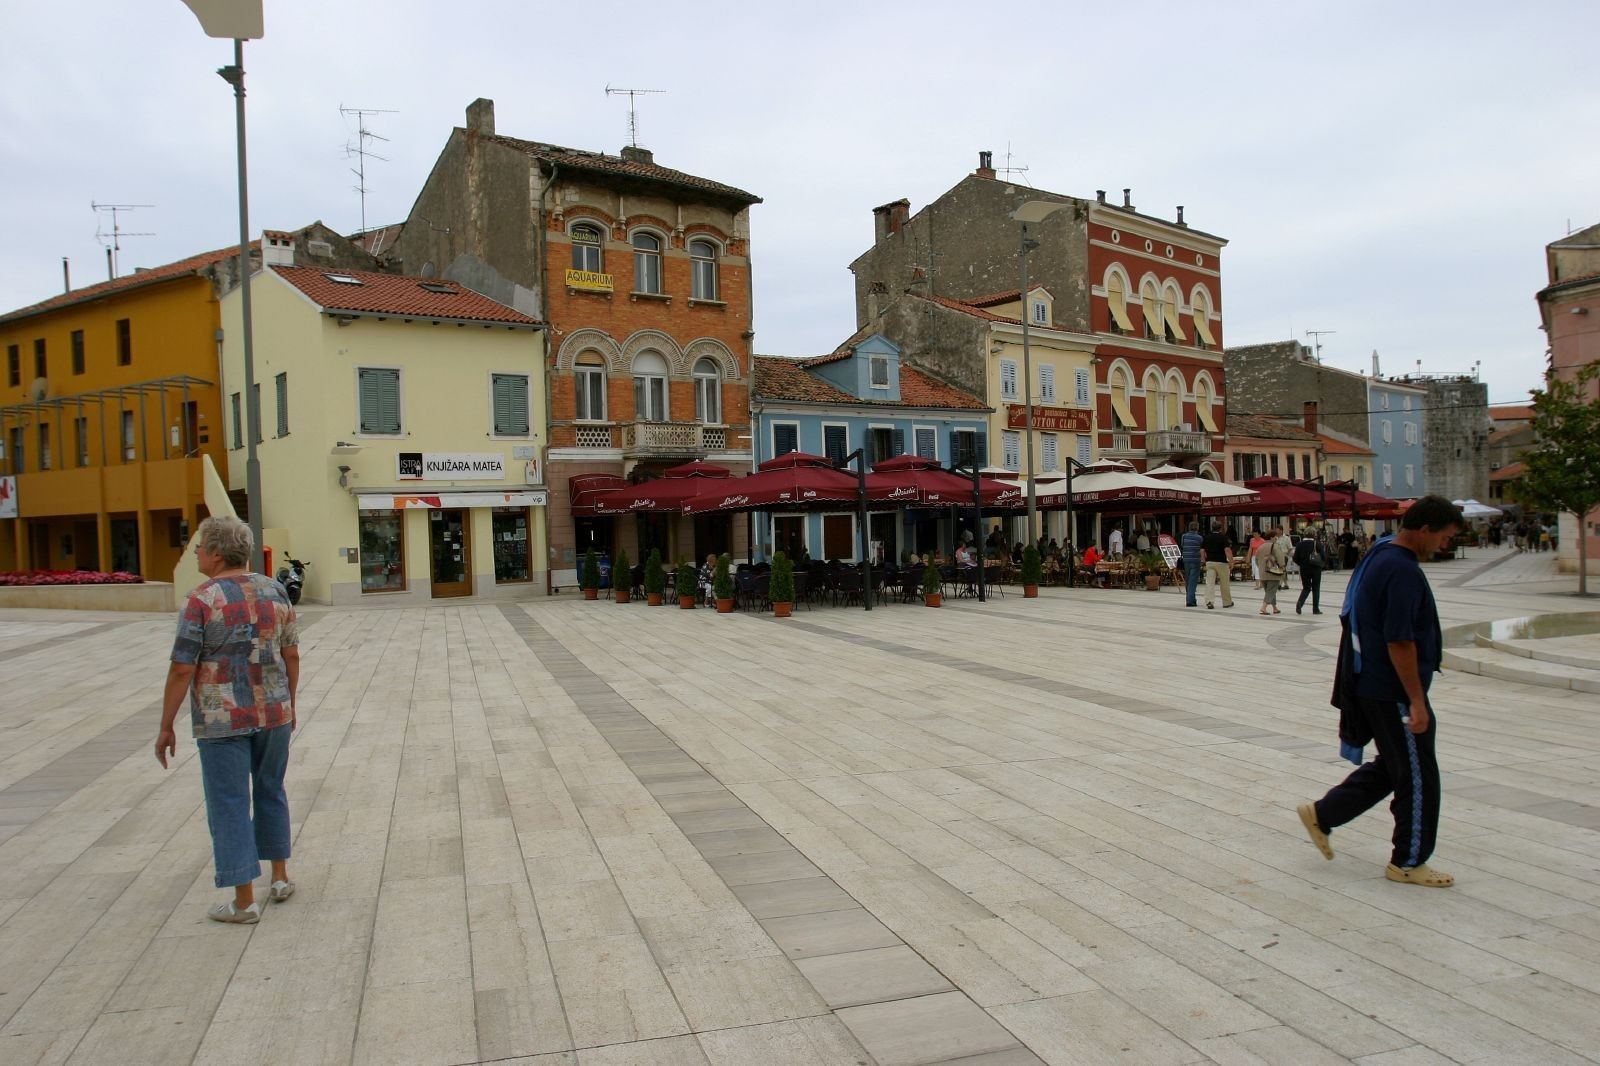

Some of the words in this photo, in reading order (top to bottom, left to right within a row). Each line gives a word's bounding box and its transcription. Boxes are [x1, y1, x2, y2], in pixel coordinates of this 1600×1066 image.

[566, 271, 613, 285] AQUARIUM
[1031, 417, 1056, 428] OTTON
[1059, 418, 1077, 429] CLUB
[400, 459, 422, 468] ISTRA
[426, 459, 470, 471] KNJIŽARA
[473, 461, 502, 471] MATEA
